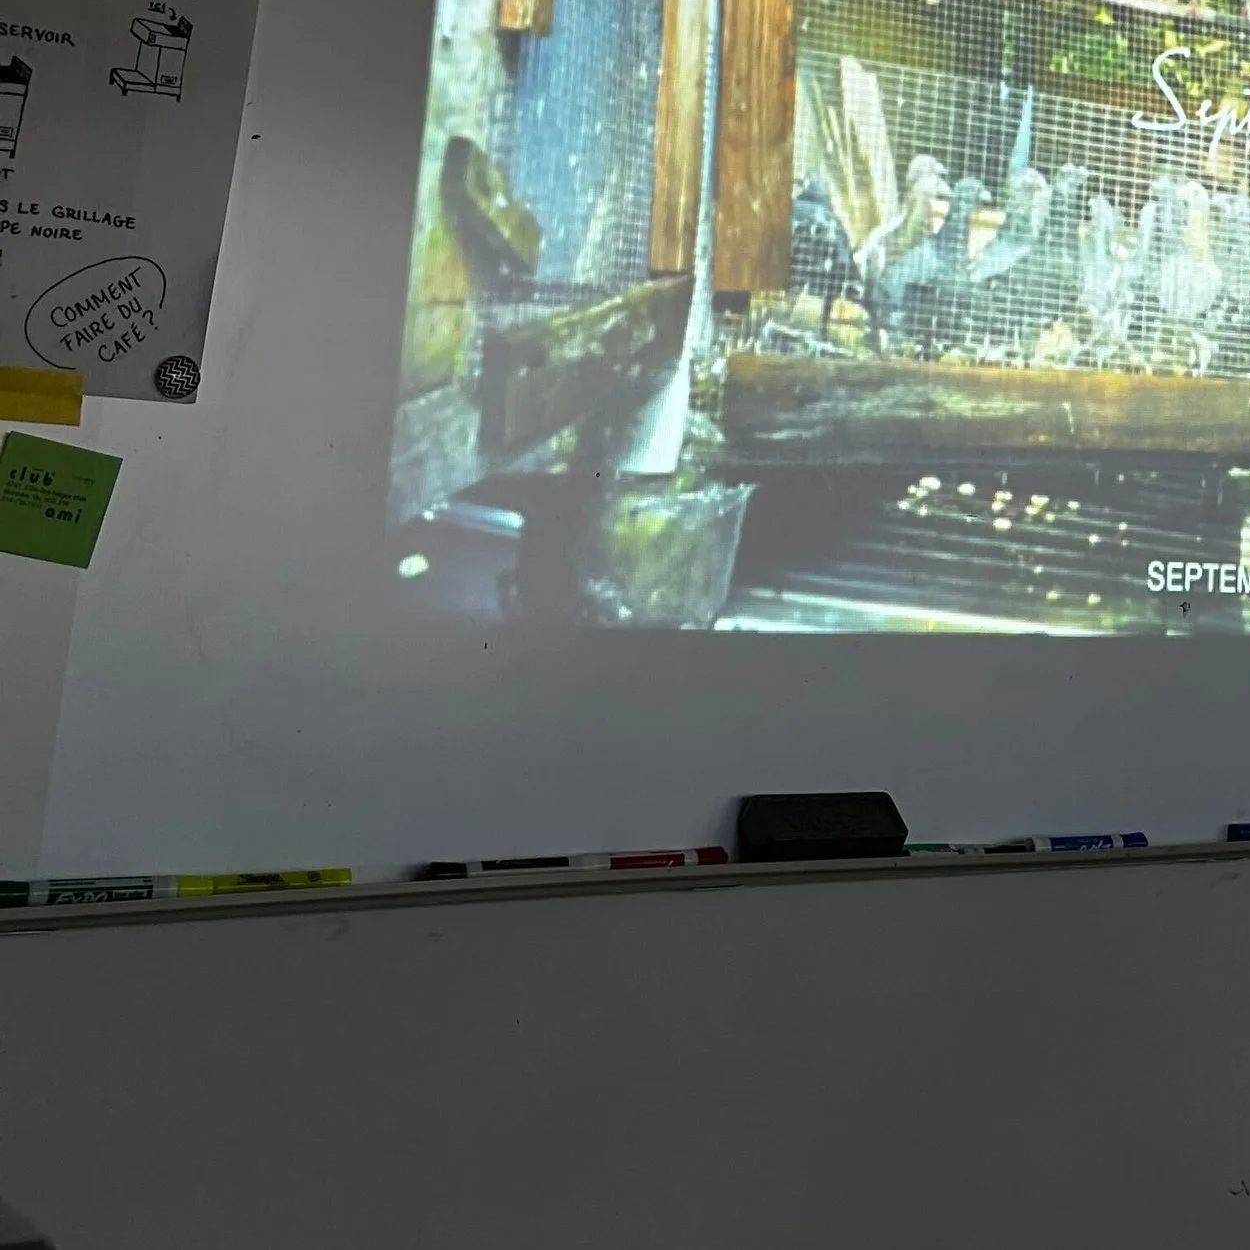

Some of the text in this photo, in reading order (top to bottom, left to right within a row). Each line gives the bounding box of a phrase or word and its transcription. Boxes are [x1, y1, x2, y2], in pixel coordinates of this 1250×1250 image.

[0, 22, 75, 48] SERVOIR
[18, 202, 40, 215] LE
[52, 206, 136, 229] GRILLAGE
[31, 225, 82, 240] NOIRE
[50, 266, 141, 327] COMMENT
[60, 297, 143, 352] FAIRE DU
[9, 467, 52, 486] club
